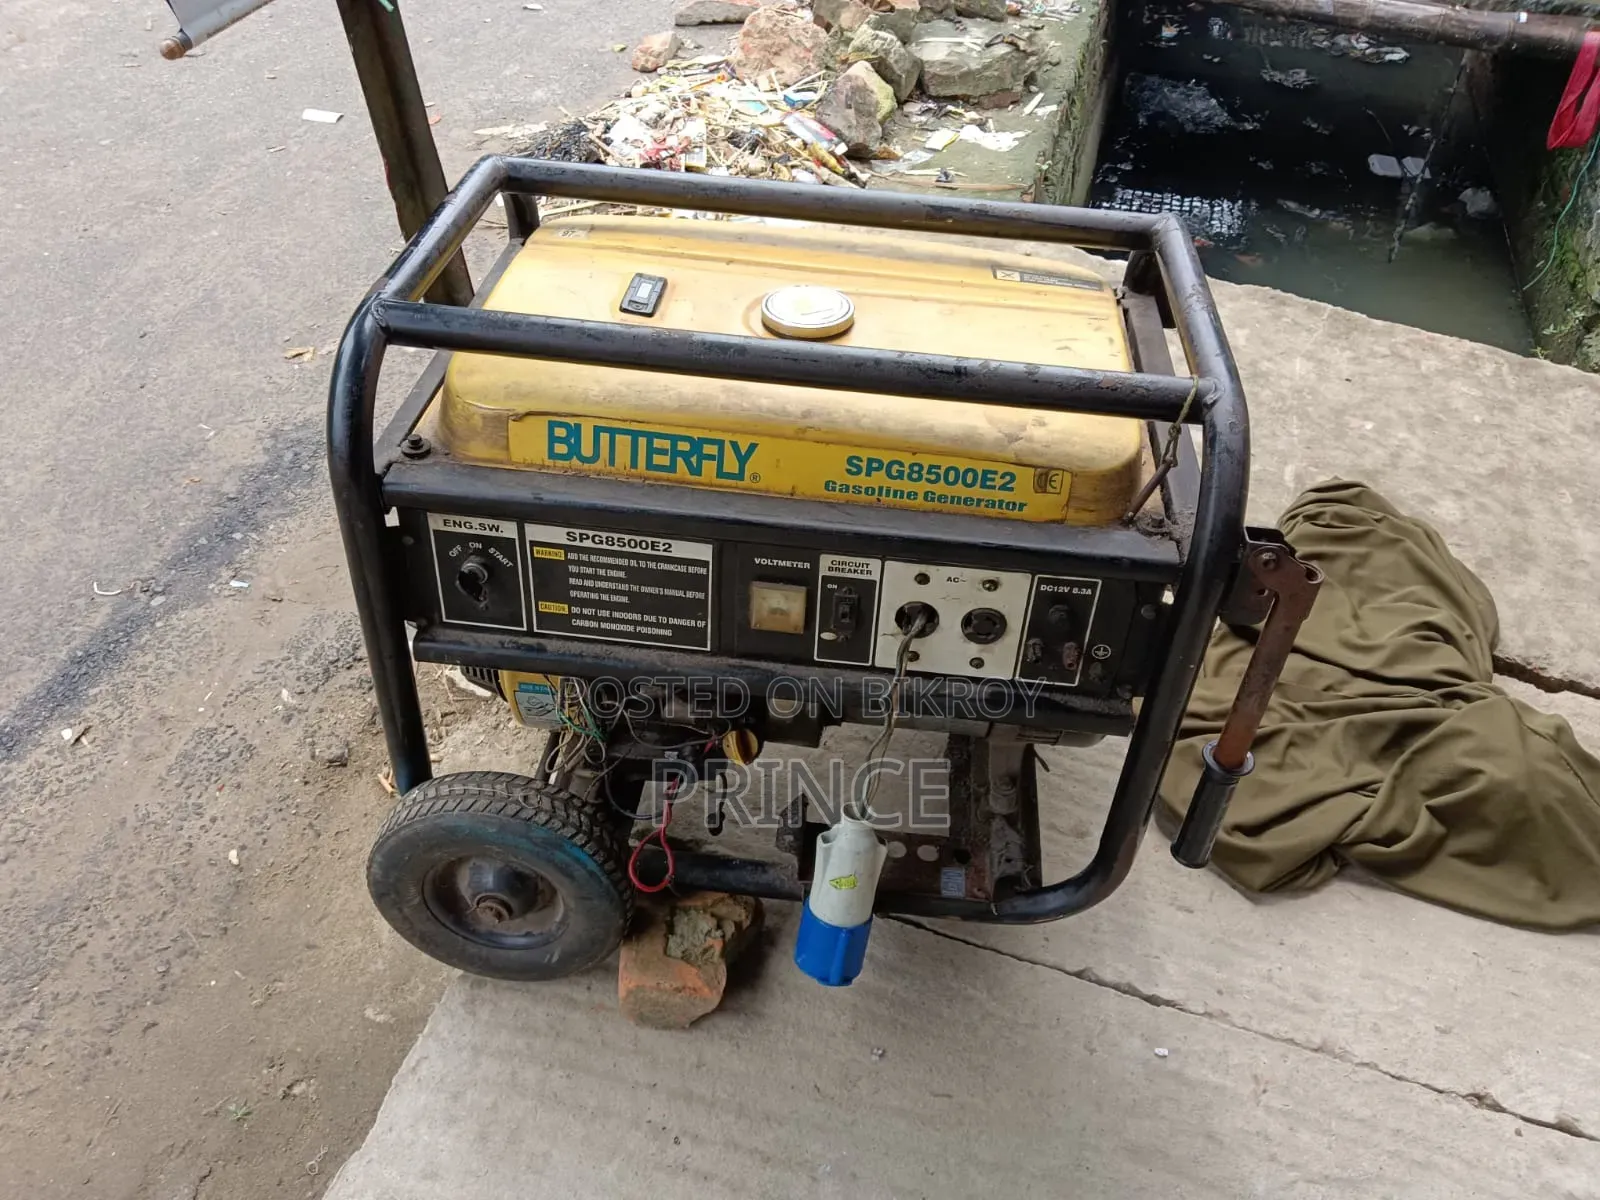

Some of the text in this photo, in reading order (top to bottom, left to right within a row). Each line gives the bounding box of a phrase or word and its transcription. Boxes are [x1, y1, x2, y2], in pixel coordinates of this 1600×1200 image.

[547, 420, 759, 482] BUTTERFLY
[845, 455, 1016, 493] SPG8500E2
[824, 479, 1028, 512] Gasoline Generator
[443, 518, 504, 533] ENG.SW.
[468, 541, 482, 549] ON
[566, 531, 673, 553] SPG8500E2
[448, 544, 463, 557] OFF
[488, 547, 514, 568] START
[567, 552, 708, 575] ADD THE RECOMMENDED OIL TO THE CRANKCASE BEFORE
[568, 564, 579, 573] YOU
[580, 566, 596, 575] START
[596, 567, 607, 576] THE
[754, 557, 811, 569] VOLTMETER
[827, 566, 873, 576] BREAKER
[830, 560, 870, 569] CIRCUIT
[568, 577, 583, 586] READ
[583, 578, 594, 587] AND
[595, 579, 629, 591] UNDERSTAND
[630, 583, 640, 592] THE
[640, 584, 664, 595] OWNER'S
[664, 587, 685, 598] MANUAL
[1040, 584, 1070, 594] DC12V
[569, 590, 599, 601] OPERATING
[600, 592, 610, 602] THE
[571, 606, 706, 629] DO NOT USE INDOORS DUE TO DANGER OF
[571, 618, 673, 636] CARBON MONOXIDE POISONING
